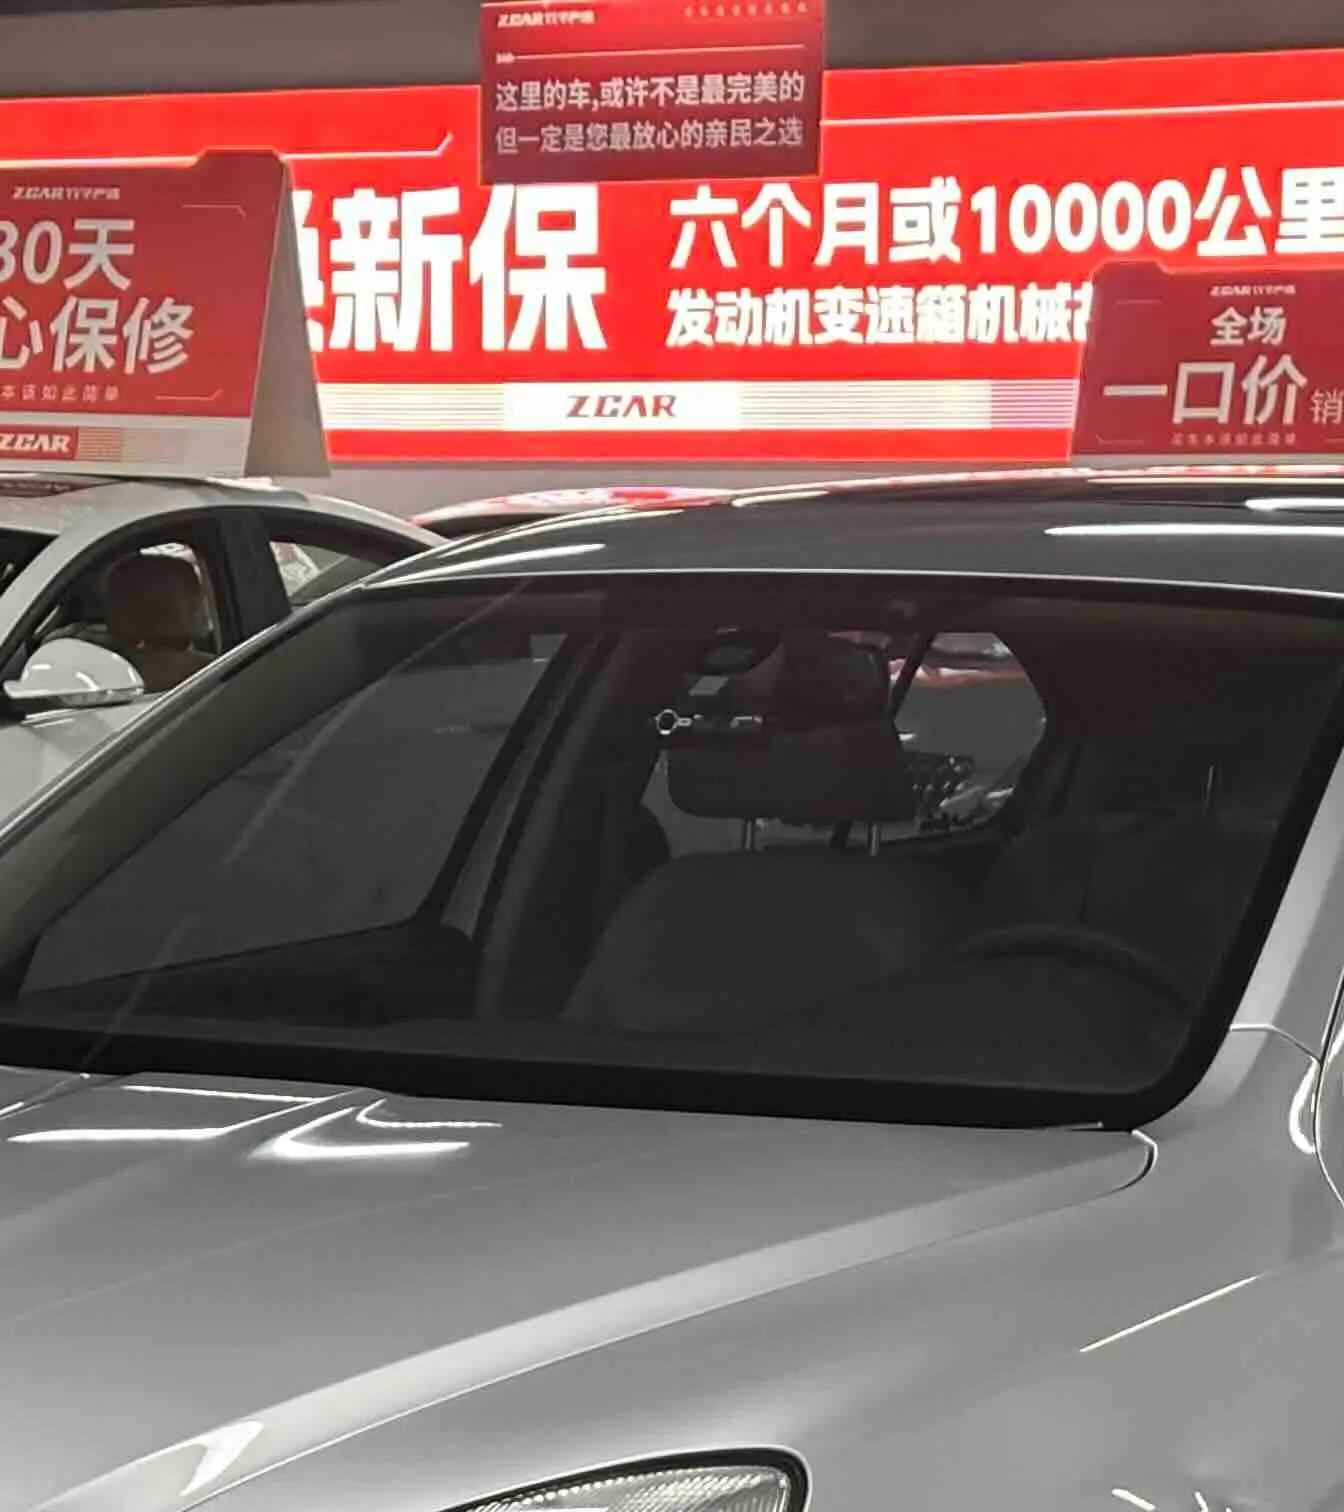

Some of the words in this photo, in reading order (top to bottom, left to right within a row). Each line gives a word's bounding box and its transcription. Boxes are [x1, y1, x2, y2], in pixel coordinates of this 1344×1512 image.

[495, 71, 805, 112] 这里的车,或许不是最完美的
[495, 116, 804, 154] 但一定是您最放心的亲民之选
[1210, 305, 1288, 346] 全场
[566, 393, 677, 419] ZCAR
[1103, 354, 1309, 425] 一口价
